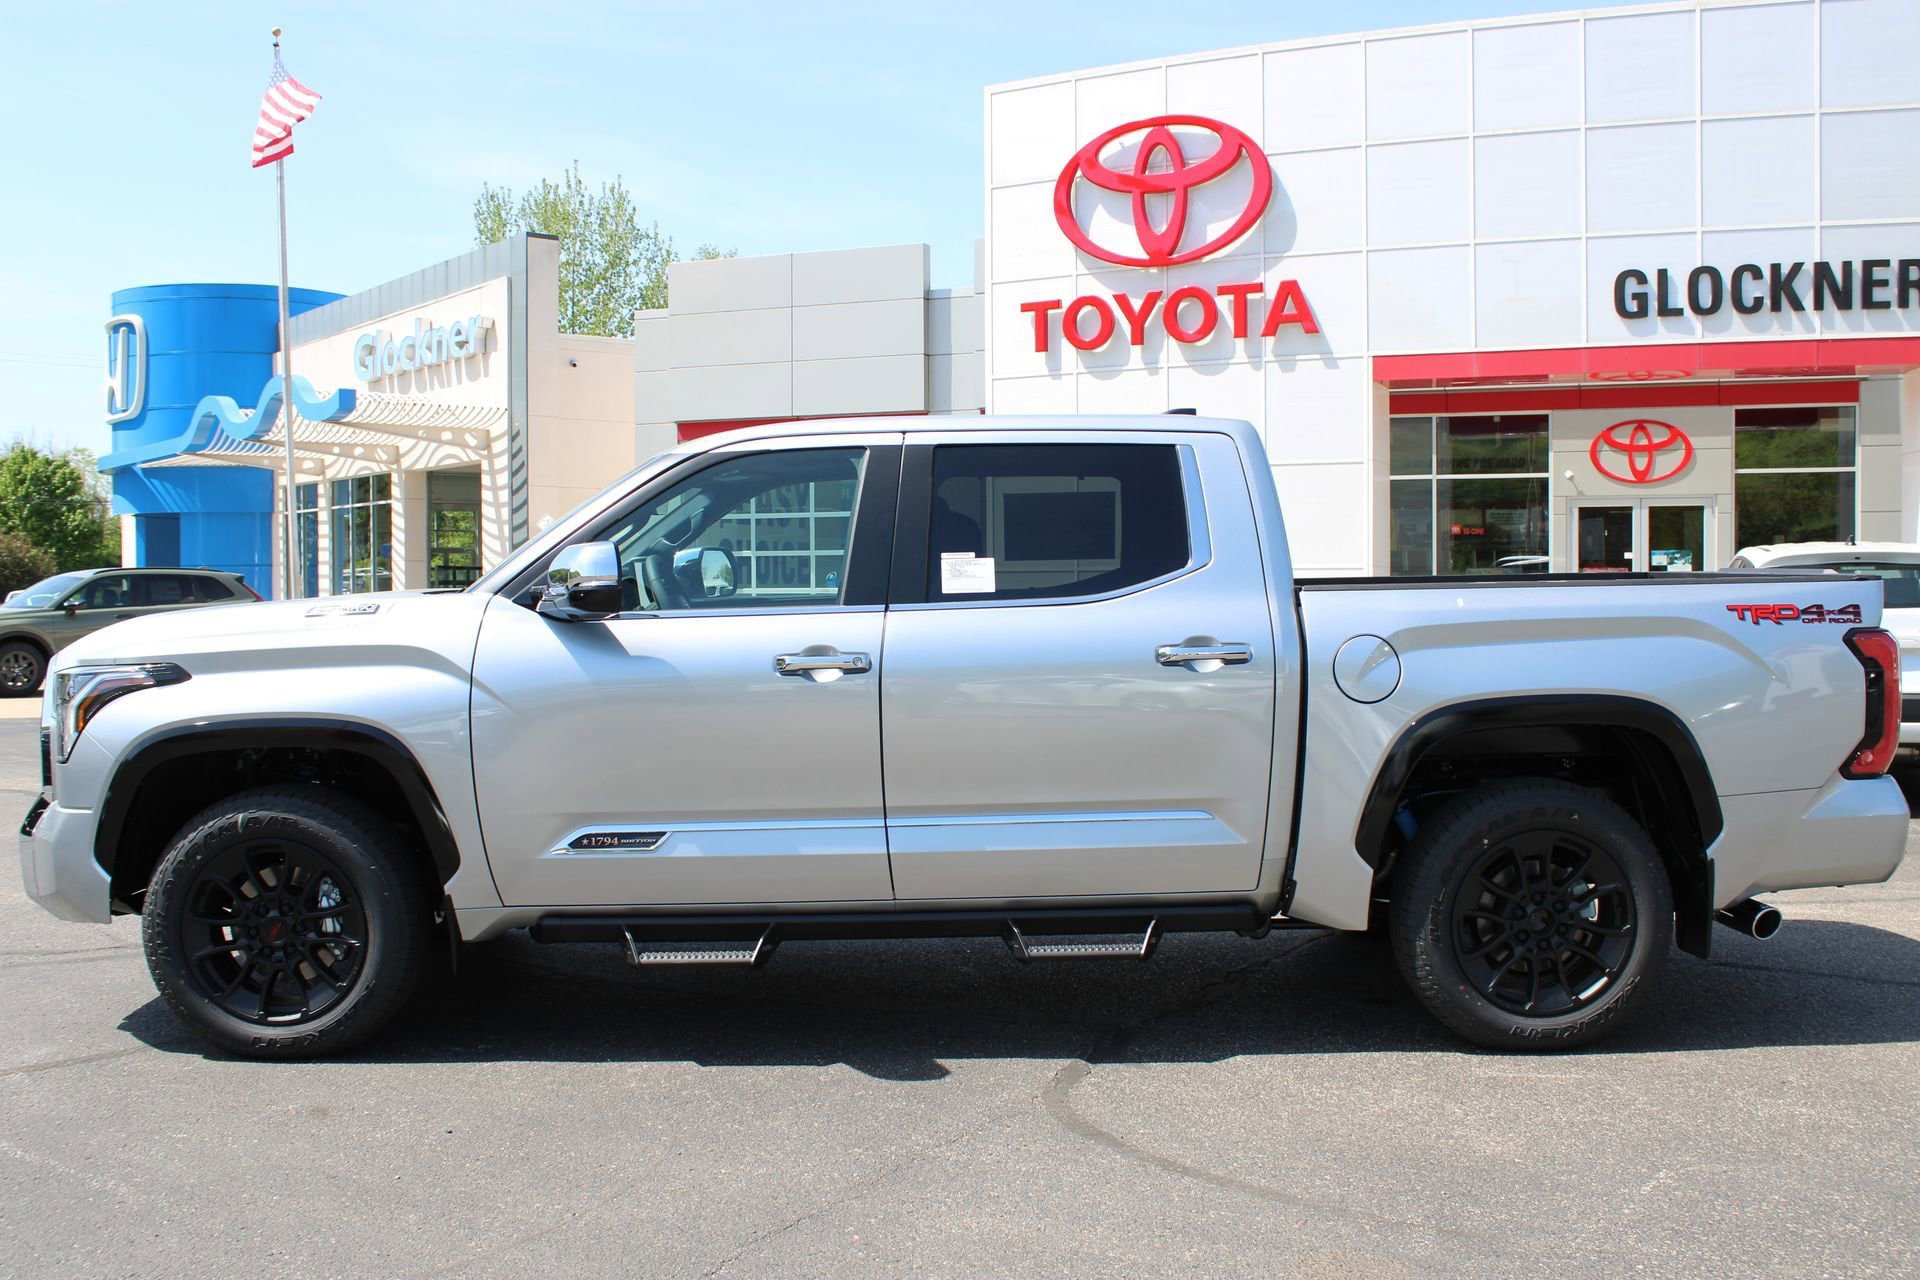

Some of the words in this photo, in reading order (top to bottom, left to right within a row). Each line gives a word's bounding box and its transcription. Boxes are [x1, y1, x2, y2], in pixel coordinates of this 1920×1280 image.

[1020, 279, 1320, 353] TOYOTA
[354, 314, 494, 382] Glockner
[719, 538, 810, 584] HOICE
[1726, 604, 1802, 625] TRD
[590, 836, 619, 846] 1794
